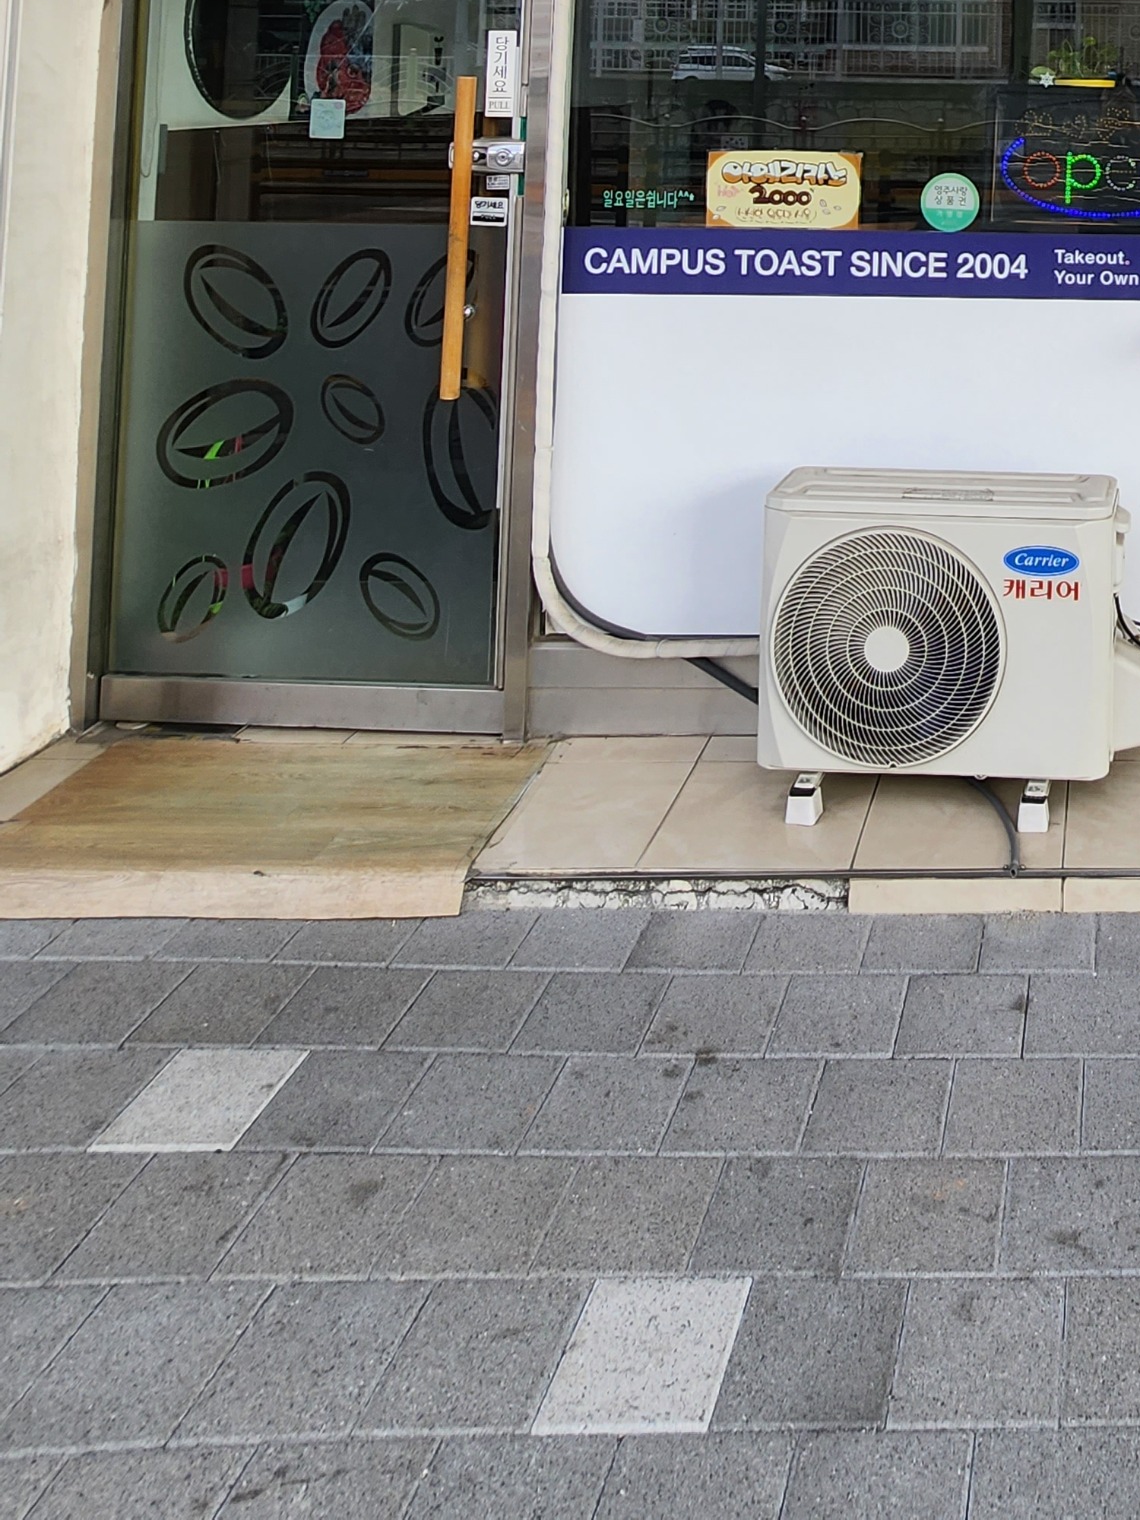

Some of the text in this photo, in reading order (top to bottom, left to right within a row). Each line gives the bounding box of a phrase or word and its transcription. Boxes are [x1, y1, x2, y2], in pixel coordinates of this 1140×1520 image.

[492, 36, 510, 93] 당기세요
[488, 100, 511, 110] PULL
[721, 159, 848, 186] 아메리카노
[934, 185, 967, 196] 영주사랑
[584, 247, 1028, 279] CAMPUS TOAST SINCE 2004
[1054, 249, 1131, 265] Takeout.
[1054, 270, 1095, 285] Your
[1100, 270, 1139, 286] Own
[1014, 553, 1070, 567] Carrier
[1003, 579, 1080, 601] 캐리어
